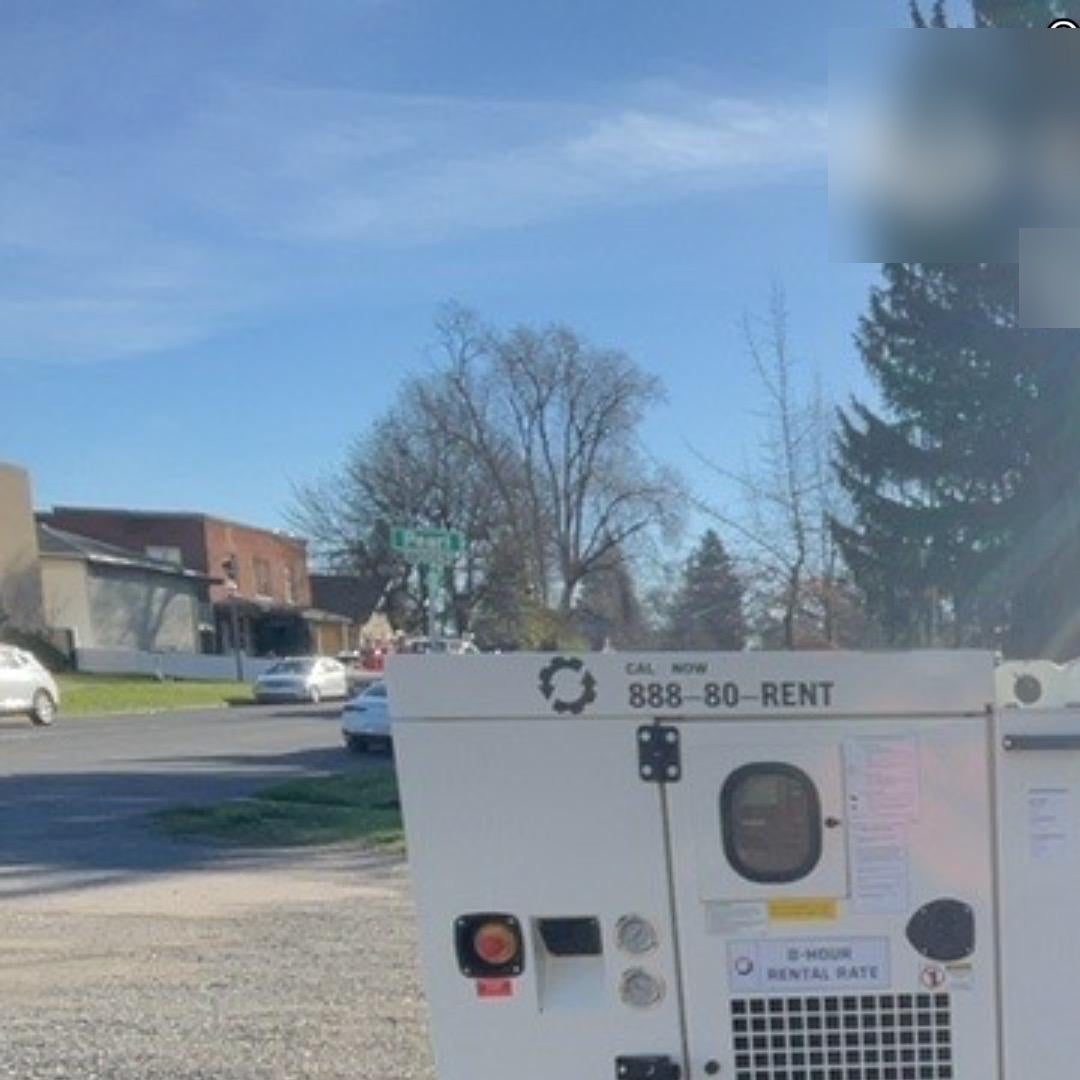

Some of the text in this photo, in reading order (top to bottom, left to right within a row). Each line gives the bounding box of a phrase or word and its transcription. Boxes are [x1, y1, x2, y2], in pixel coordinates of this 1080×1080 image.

[671, 662, 708, 674] NOW
[628, 681, 835, 709] 888-80-RENT
[767, 964, 879, 981] RENTAL RATE
